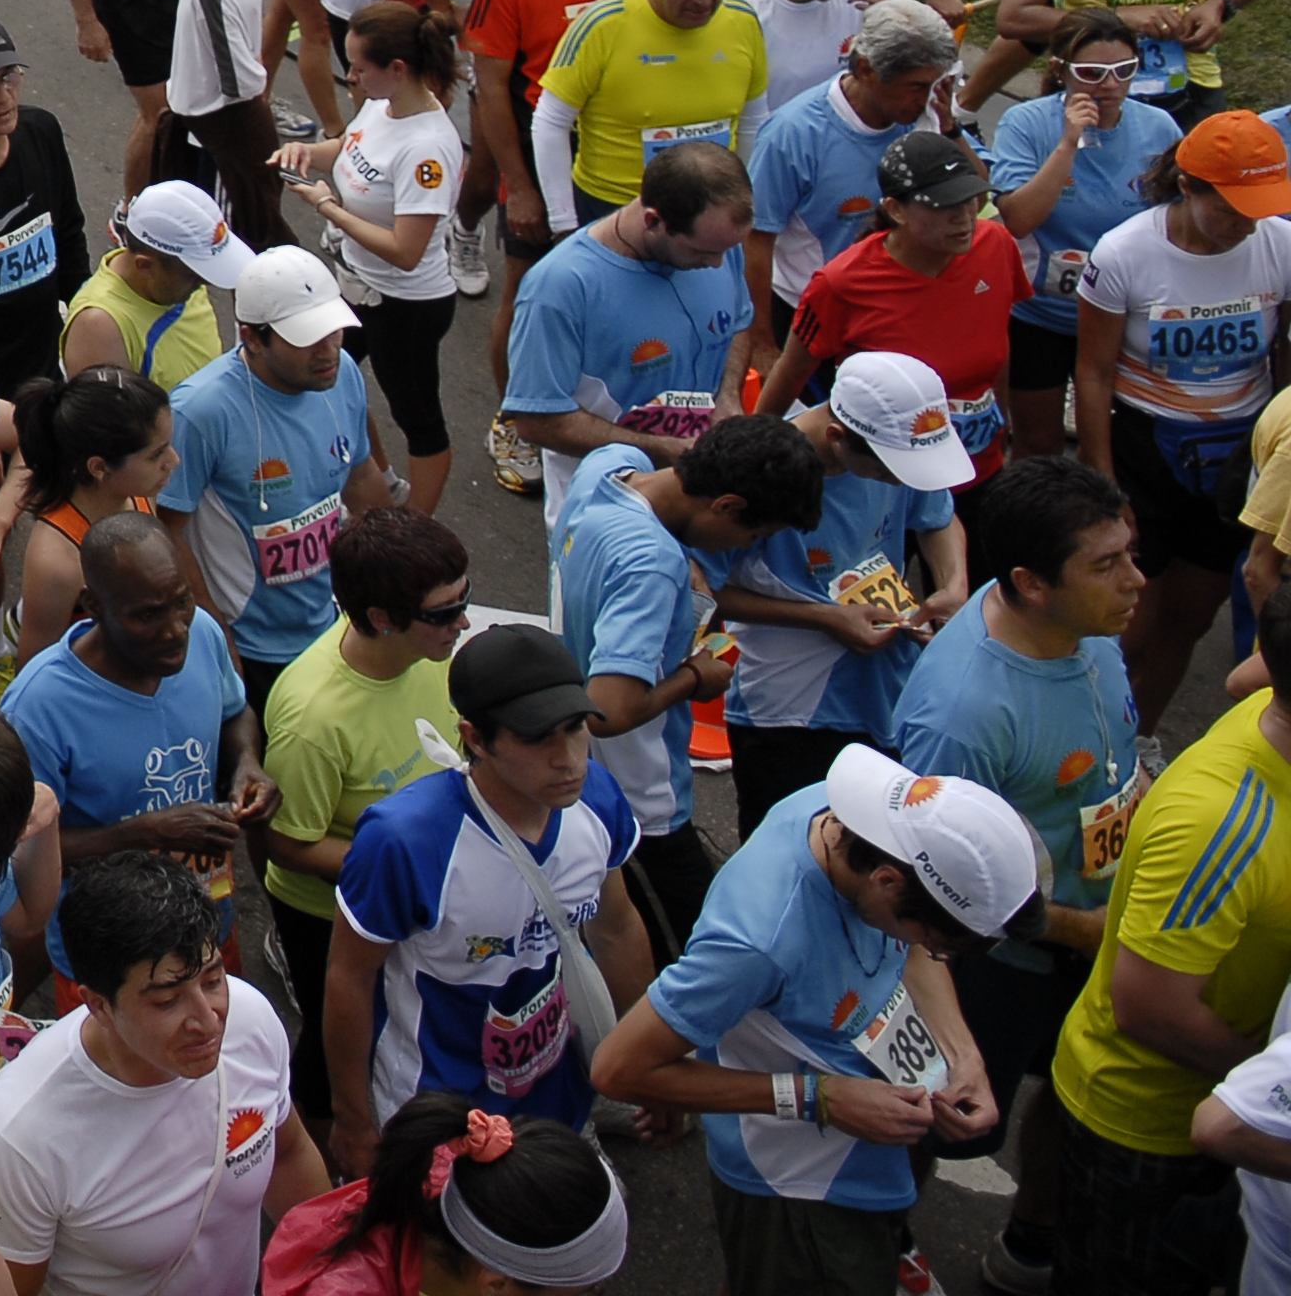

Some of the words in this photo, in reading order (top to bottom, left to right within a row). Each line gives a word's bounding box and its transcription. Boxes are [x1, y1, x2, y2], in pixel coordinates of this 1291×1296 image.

[676, 121, 725, 139] Porvenir
[7, 217, 45, 247] Porvenir
[141, 231, 184, 255] Porvenir
[1191, 300, 1252, 320] Porvenir
[1151, 320, 1259, 358] 10465
[666, 393, 710, 407] Porvenir
[620, 406, 712, 436] 22926
[834, 402, 879, 436] Porvenir
[290, 498, 338, 529] Porvenir
[914, 850, 972, 911] Porvenir
[225, 1126, 274, 1169] Porvenir
